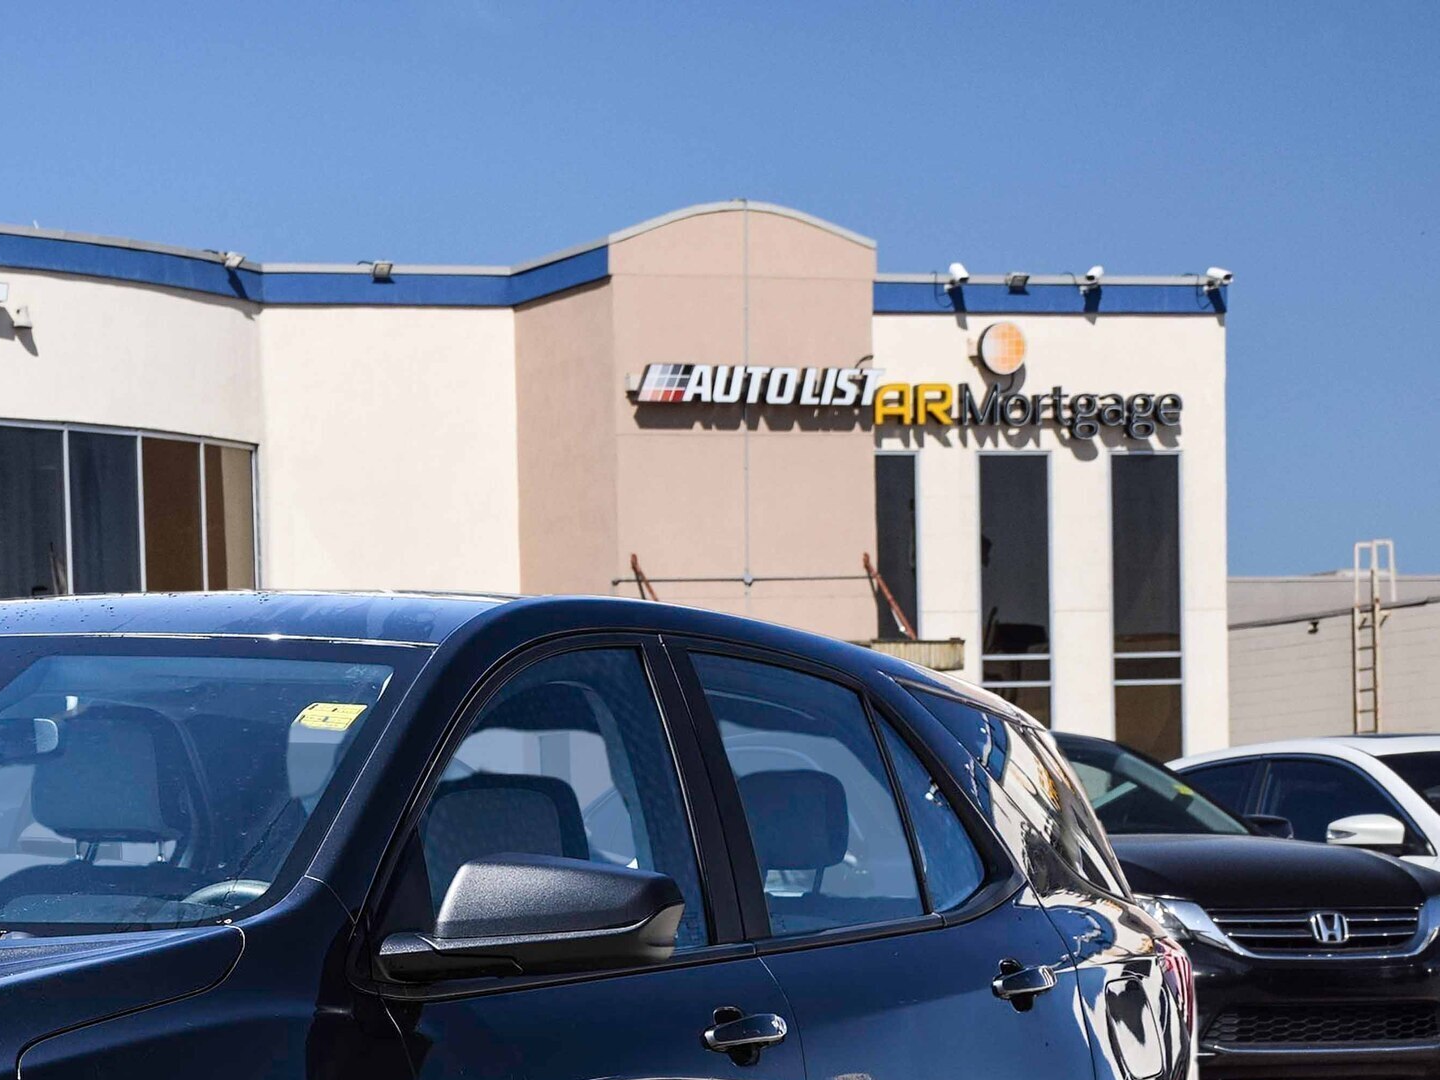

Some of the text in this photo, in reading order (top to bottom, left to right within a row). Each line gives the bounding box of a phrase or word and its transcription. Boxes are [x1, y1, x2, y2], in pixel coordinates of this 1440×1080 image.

[682, 364, 886, 406] AUTO LIST
[875, 382, 1184, 440] AR Mortgage
